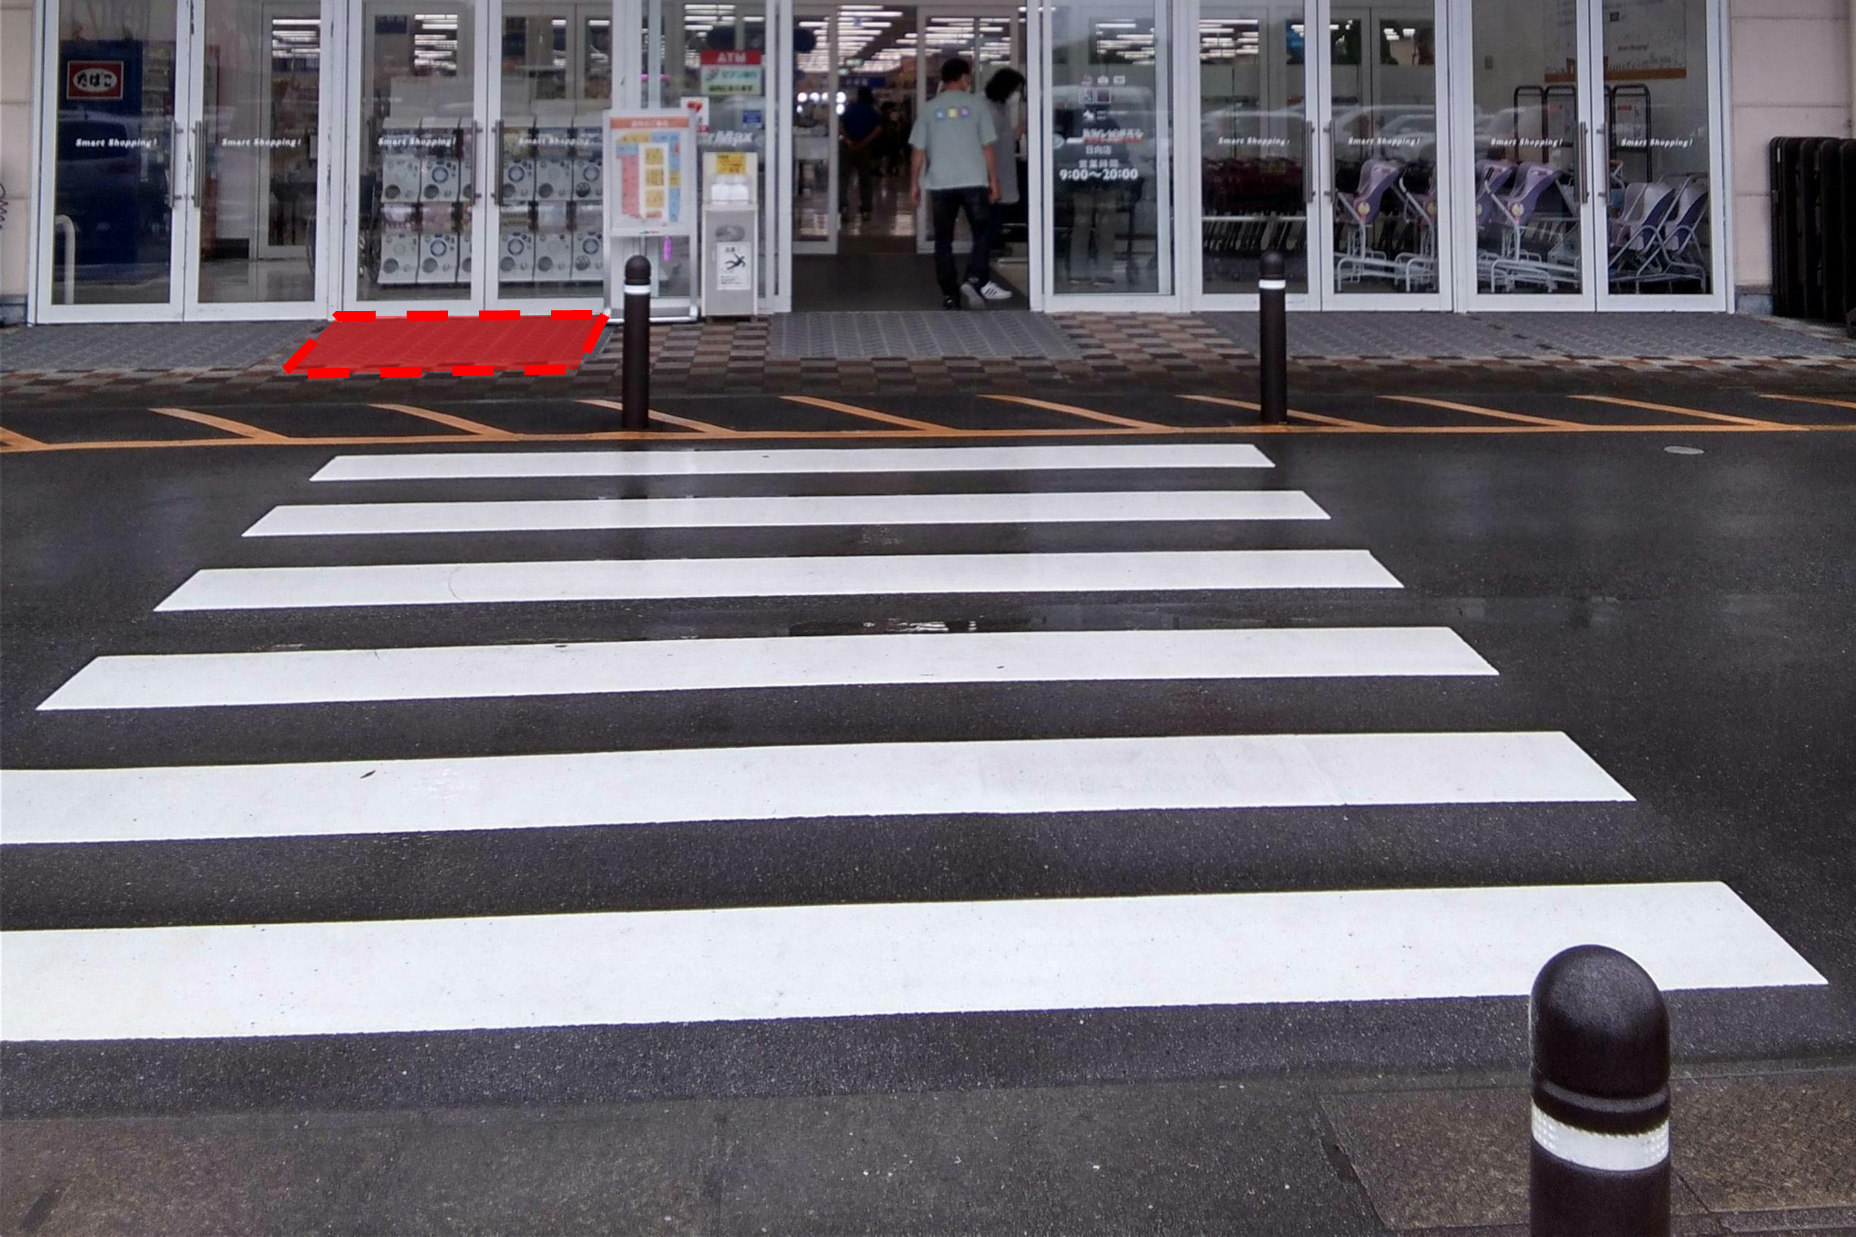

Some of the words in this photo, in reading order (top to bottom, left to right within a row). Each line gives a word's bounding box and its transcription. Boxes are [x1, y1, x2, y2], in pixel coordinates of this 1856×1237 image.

[717, 51, 747, 64] ATM
[76, 71, 113, 88] たばこ
[75, 138, 105, 148] Smart
[221, 138, 250, 148] Smart
[378, 137, 407, 147] Smart
[1218, 136, 1244, 146] Smart
[1348, 136, 1374, 146] Smart
[1490, 137, 1517, 147] Smart
[1621, 138, 1647, 148] Smart
